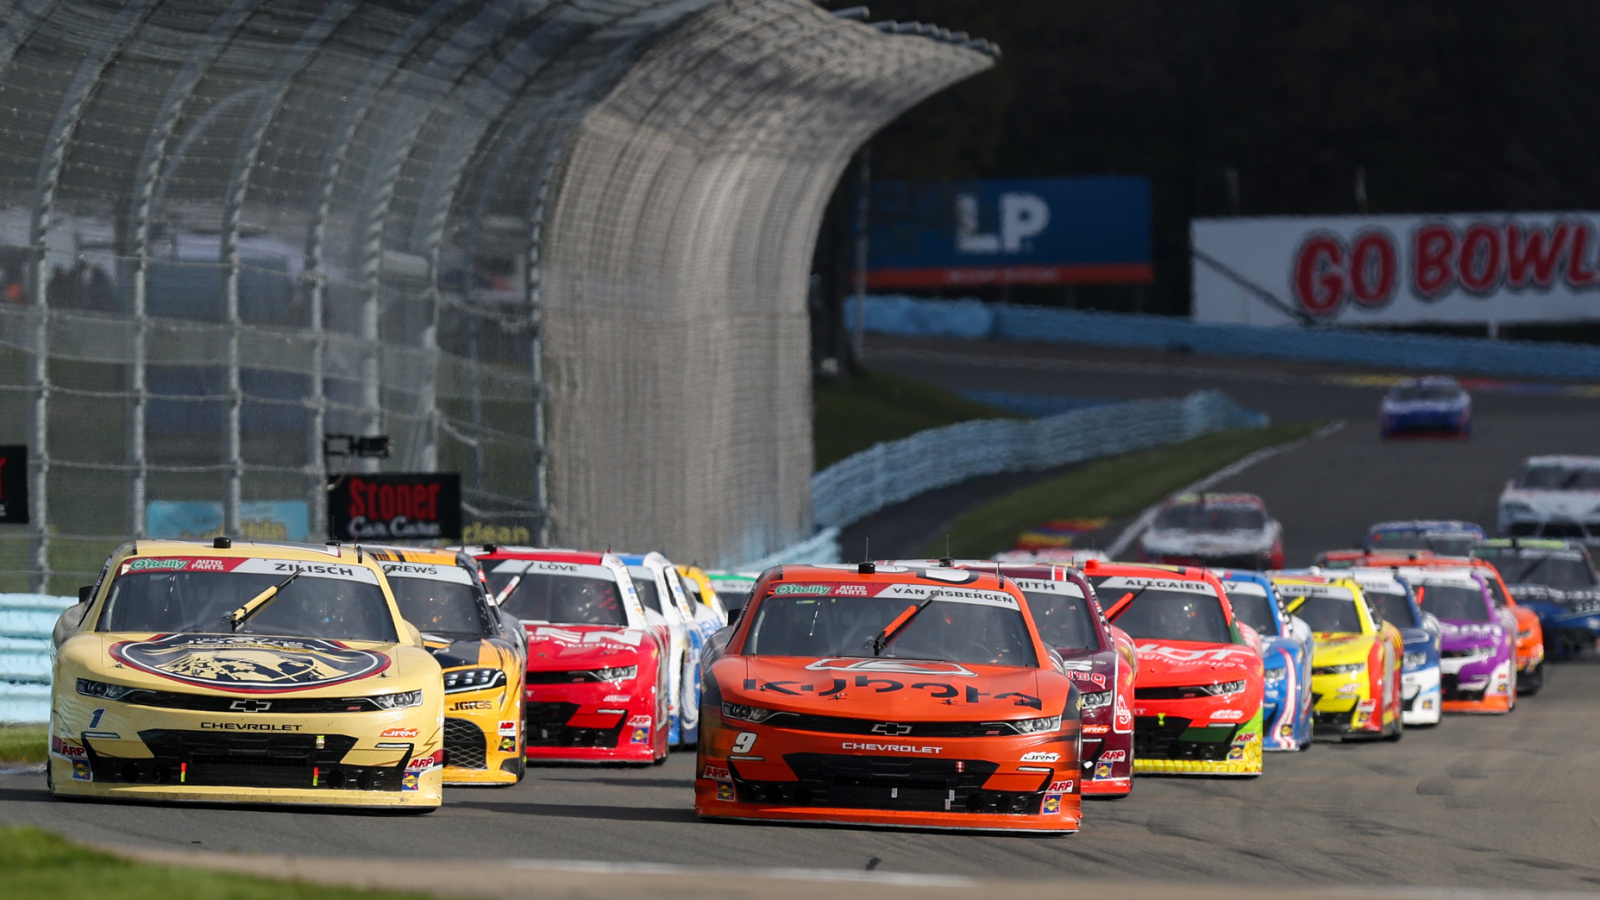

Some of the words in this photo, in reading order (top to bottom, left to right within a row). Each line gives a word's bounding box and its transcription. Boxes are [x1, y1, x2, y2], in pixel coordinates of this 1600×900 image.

[956, 192, 1050, 253] LP
[1294, 230, 1398, 316] GO
[1412, 222, 1600, 294] BOWL
[349, 478, 442, 521] Stoner
[348, 516, 388, 537] Car
[390, 516, 442, 536] Care
[129, 557, 189, 570] O'Reilly
[190, 563, 225, 571] PARTS
[274, 562, 354, 577] ZILISCH
[383, 564, 438, 575] CREWS
[539, 563, 578, 572] LOVE
[774, 584, 834, 596] O'Reilly
[834, 588, 868, 596] PARTS
[893, 587, 925, 595] VAN
[1015, 581, 1056, 591] MITH
[743, 675, 1043, 711] Kubota
[87, 707, 107, 730] 1
[200, 721, 303, 732] CHEVROLET
[382, 728, 418, 738] JRM
[732, 732, 758, 754] 9
[841, 741, 943, 754] CHEVROLET
[61, 744, 86, 756] ARP
[1100, 750, 1125, 761] ARP
[408, 756, 435, 768] ARP
[1022, 753, 1057, 762] JRM
[704, 765, 730, 778] ARP
[1047, 780, 1073, 792] ARP
